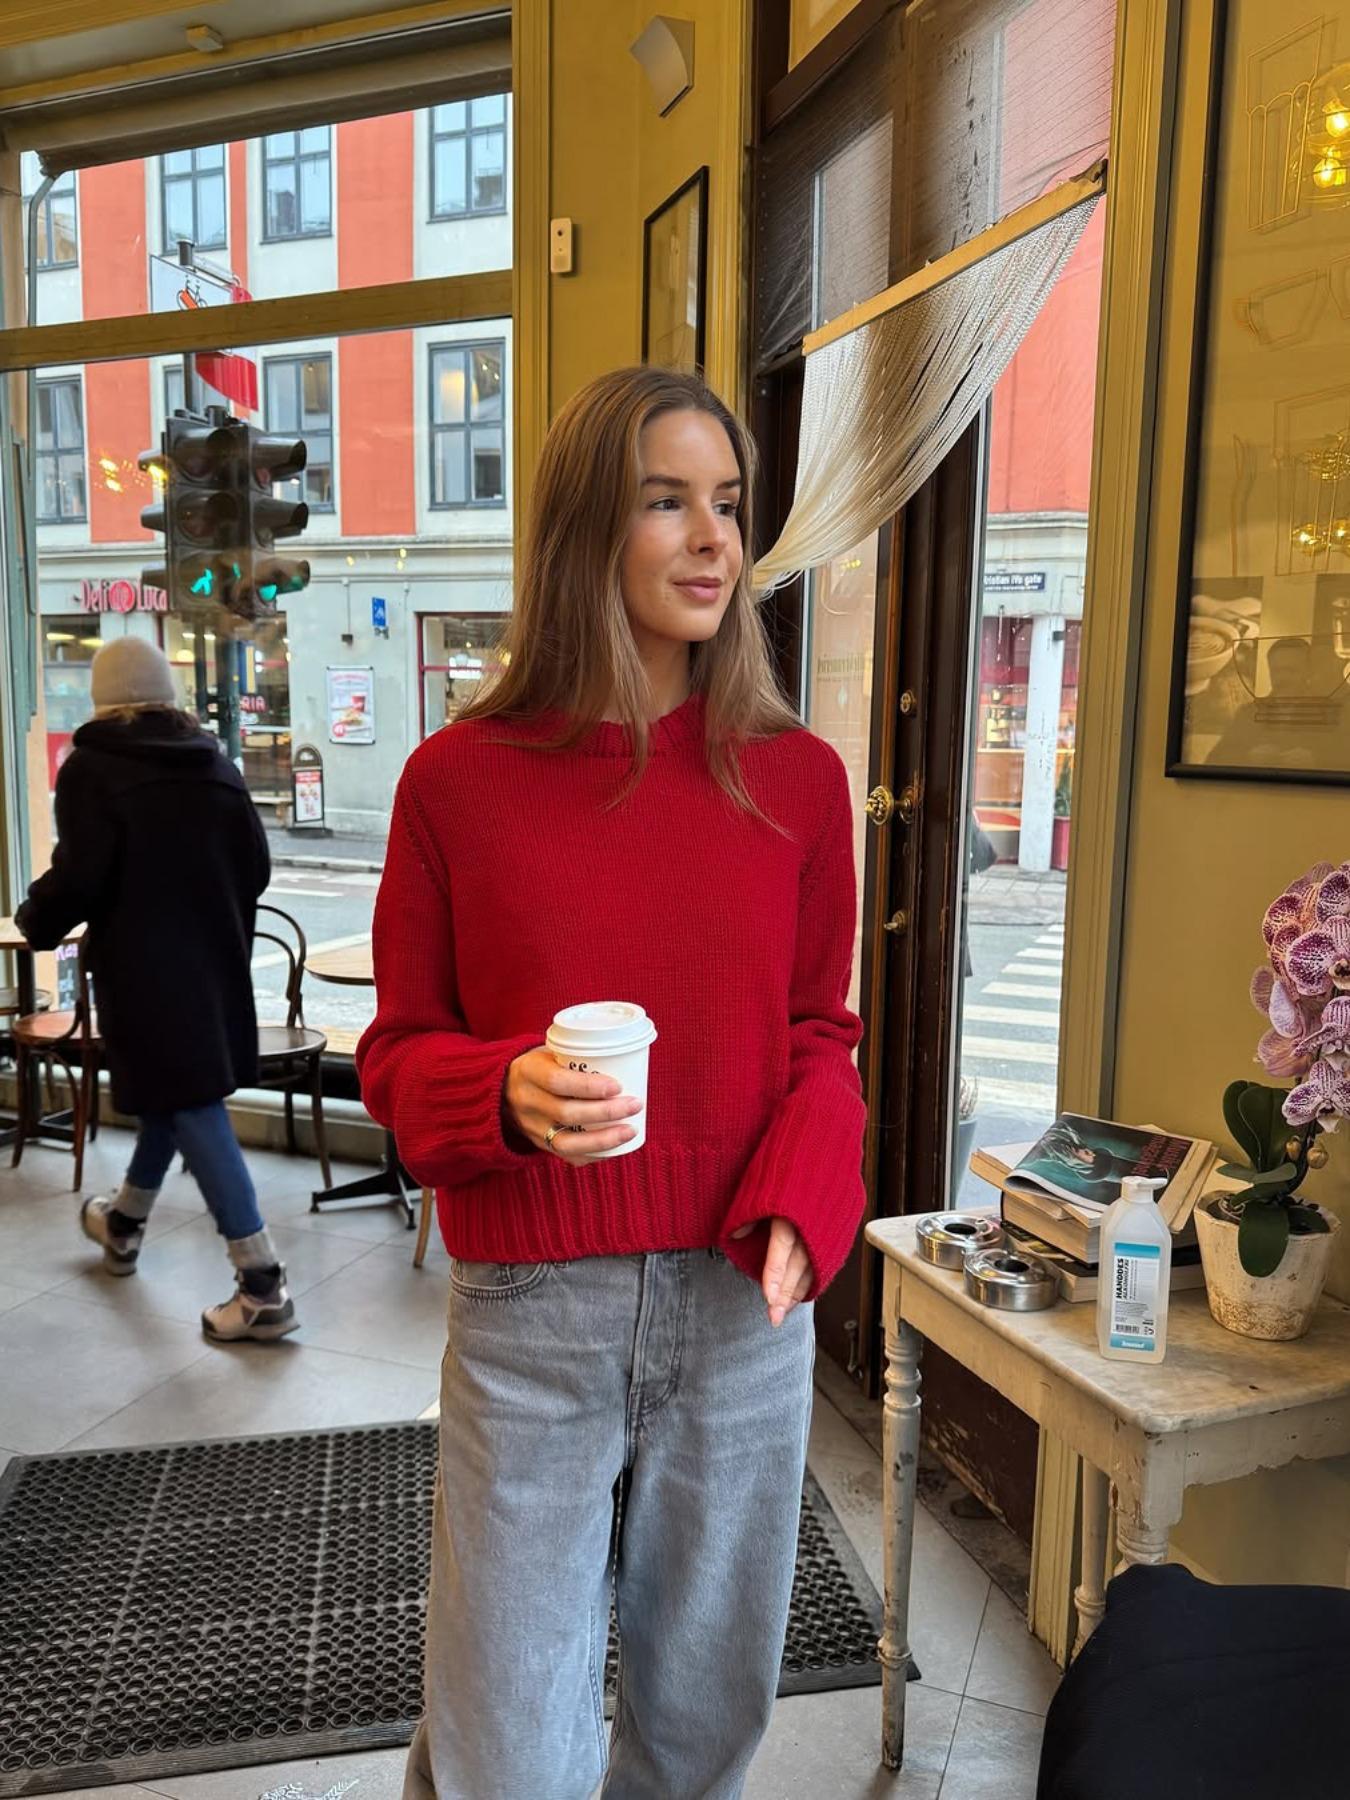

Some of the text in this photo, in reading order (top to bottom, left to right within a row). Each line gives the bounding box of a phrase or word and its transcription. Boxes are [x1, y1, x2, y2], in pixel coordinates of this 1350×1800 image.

[1024, 574, 1042, 586] gate
[79, 579, 109, 613] Deli
[136, 577, 168, 612] Luca
